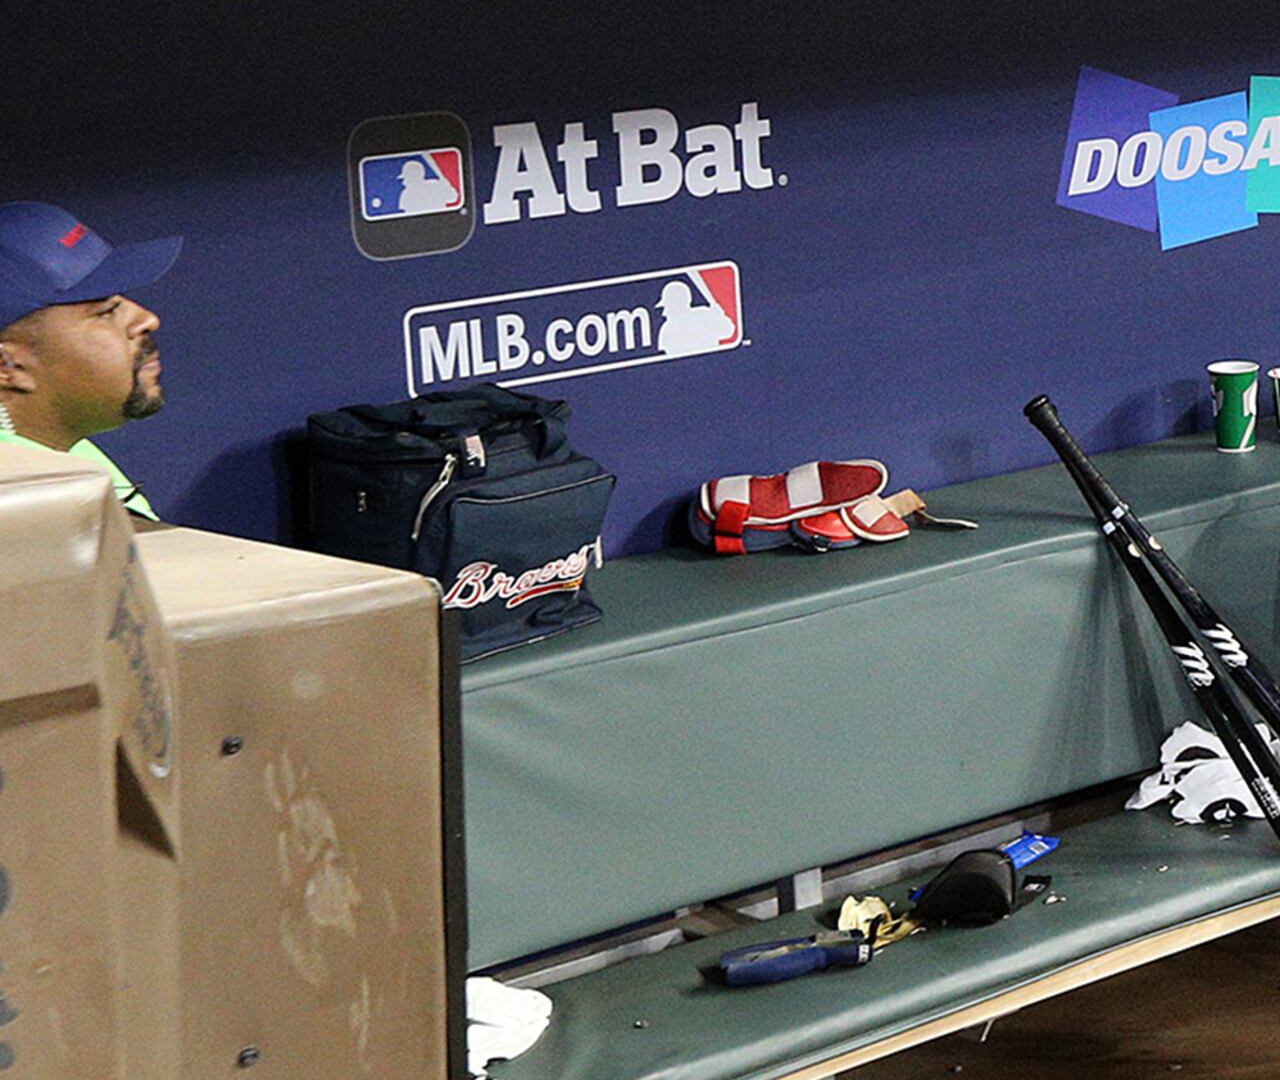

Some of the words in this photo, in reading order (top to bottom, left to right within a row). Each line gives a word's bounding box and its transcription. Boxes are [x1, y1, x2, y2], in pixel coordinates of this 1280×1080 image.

[483, 121, 602, 225] At
[612, 101, 775, 208] Bat
[418, 305, 652, 385] MLB.com
